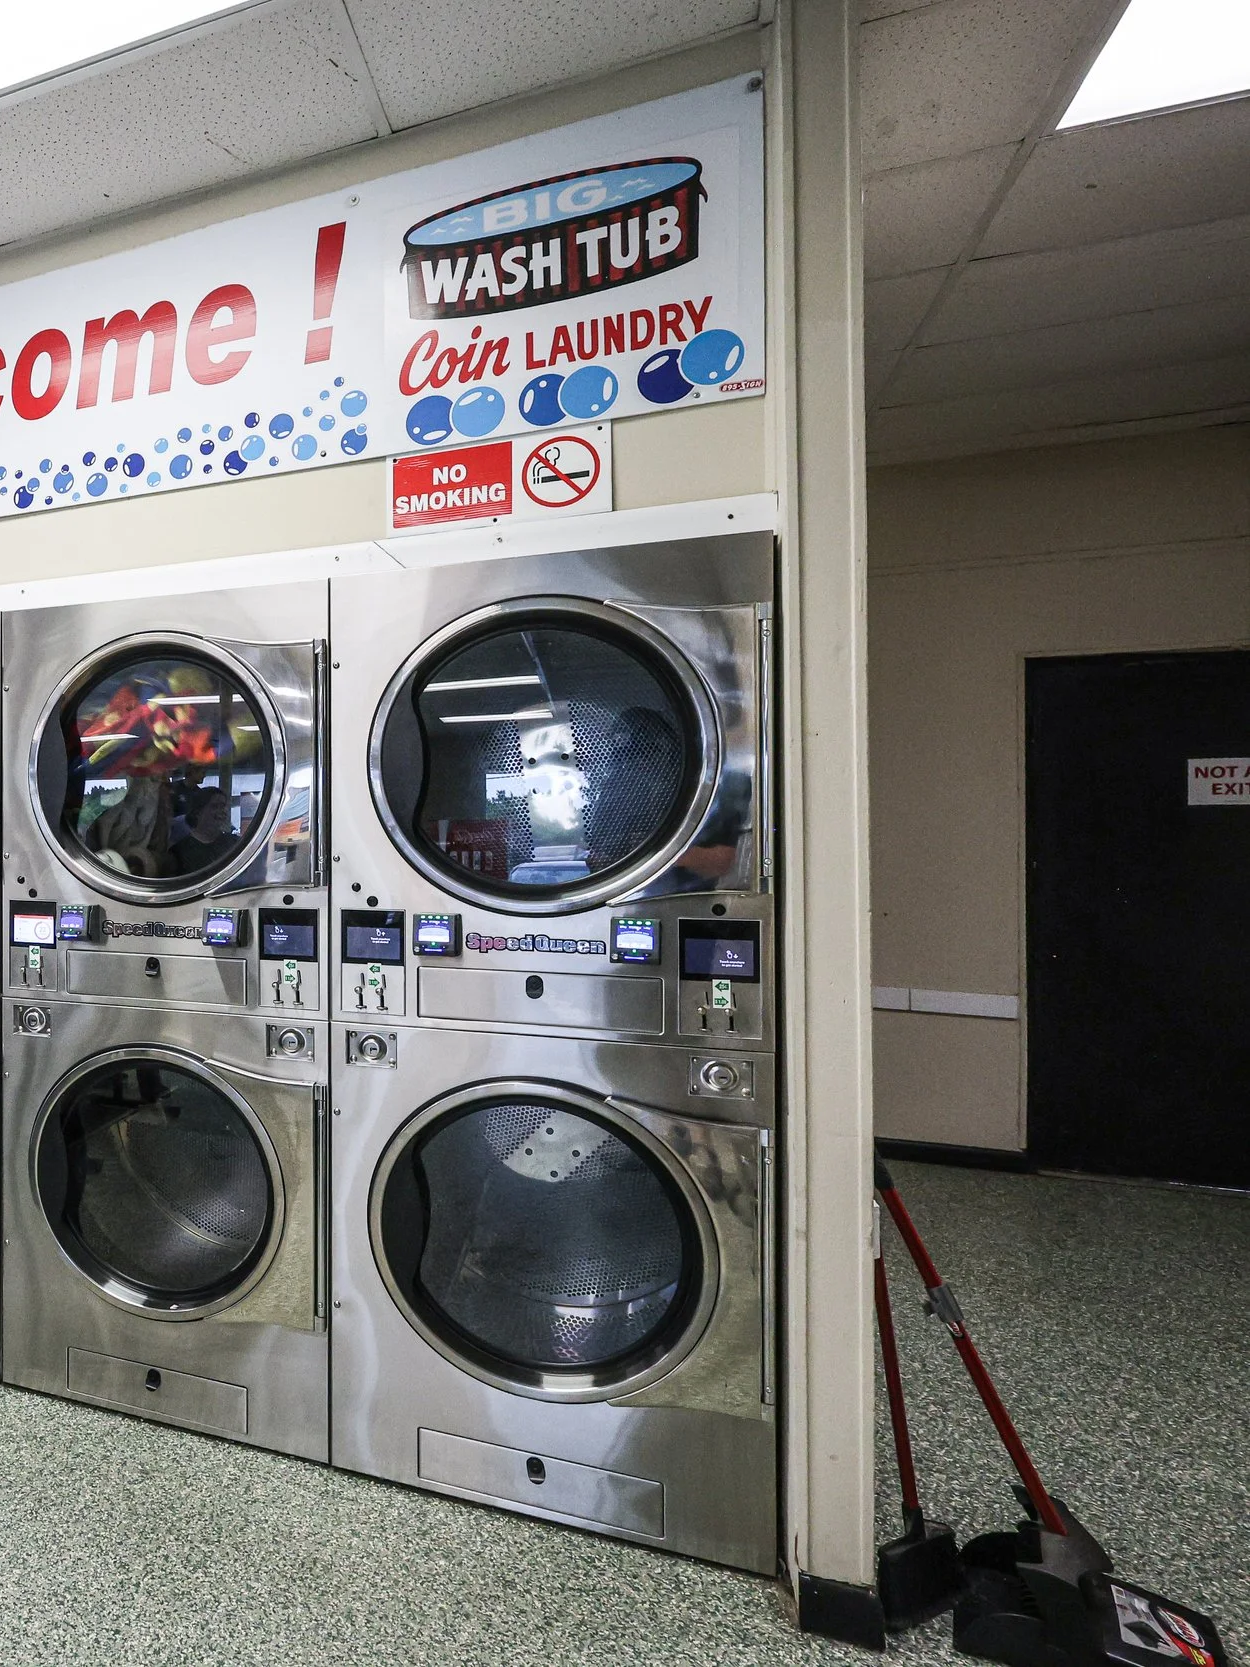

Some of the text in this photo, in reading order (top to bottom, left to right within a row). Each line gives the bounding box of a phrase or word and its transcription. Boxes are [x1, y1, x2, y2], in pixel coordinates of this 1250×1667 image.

[481, 179, 609, 234] BIG
[420, 205, 683, 305] WASH TUB
[304, 221, 347, 365] !
[398, 295, 714, 397] Coin LAUNDRY
[431, 463, 468, 487] NO
[395, 482, 506, 515] SMOKING
[1194, 765, 1239, 779] NOT
[102, 920, 153, 938] Speed
[465, 932, 607, 955] Speed Queen
